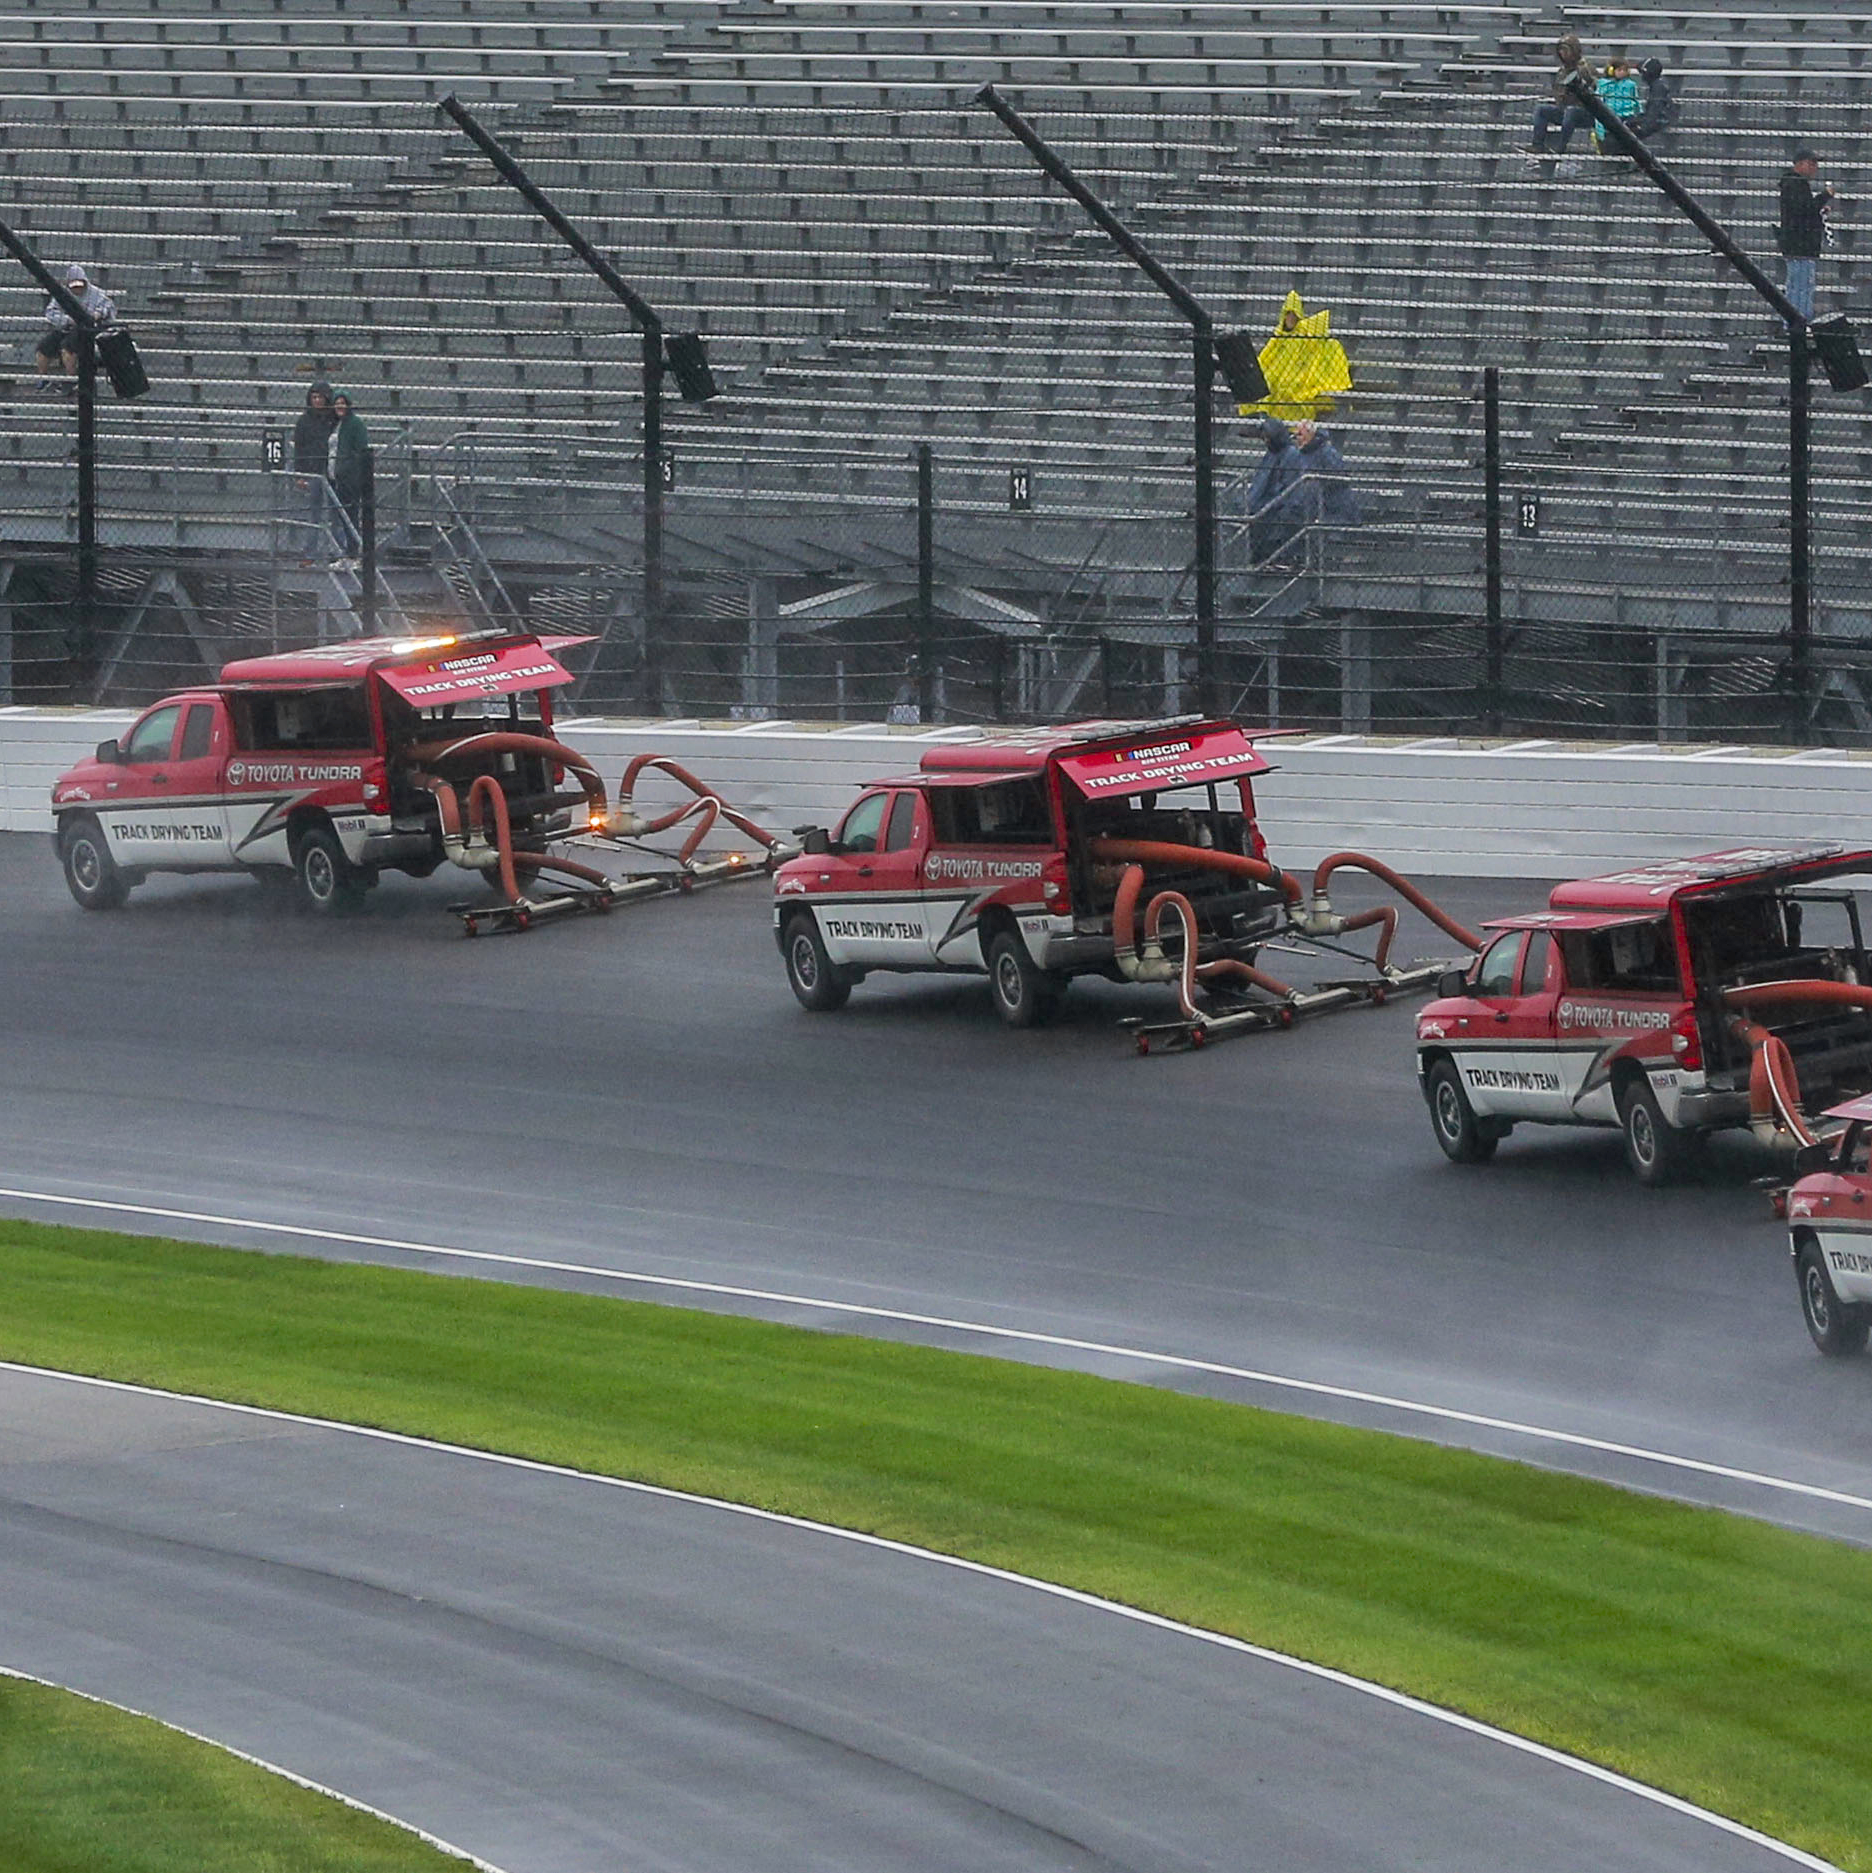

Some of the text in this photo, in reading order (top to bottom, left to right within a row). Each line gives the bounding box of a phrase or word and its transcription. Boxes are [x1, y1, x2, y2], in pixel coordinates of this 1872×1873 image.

[267, 441, 281, 463] 16
[1014, 477, 1027, 499] 14
[1522, 504, 1536, 528] 13
[444, 653, 497, 671] NASCAR
[404, 663, 556, 696] TRACK DRYING TEAM
[1133, 741, 1191, 760] NASCAR
[247, 765, 362, 783] TOYOTA TUNDRA
[1085, 752, 1255, 789] TRACK DRYING TEAM
[112, 824, 223, 841] TRACK DRYING TEAM
[942, 859, 1043, 878] TOYOTA TUNDRA
[826, 921, 923, 940] TRACK DRYING TEAM
[1573, 1006, 1671, 1030] TOYOTA TUNDRA
[1466, 1069, 1561, 1091] TRACK DRYING TEAM
